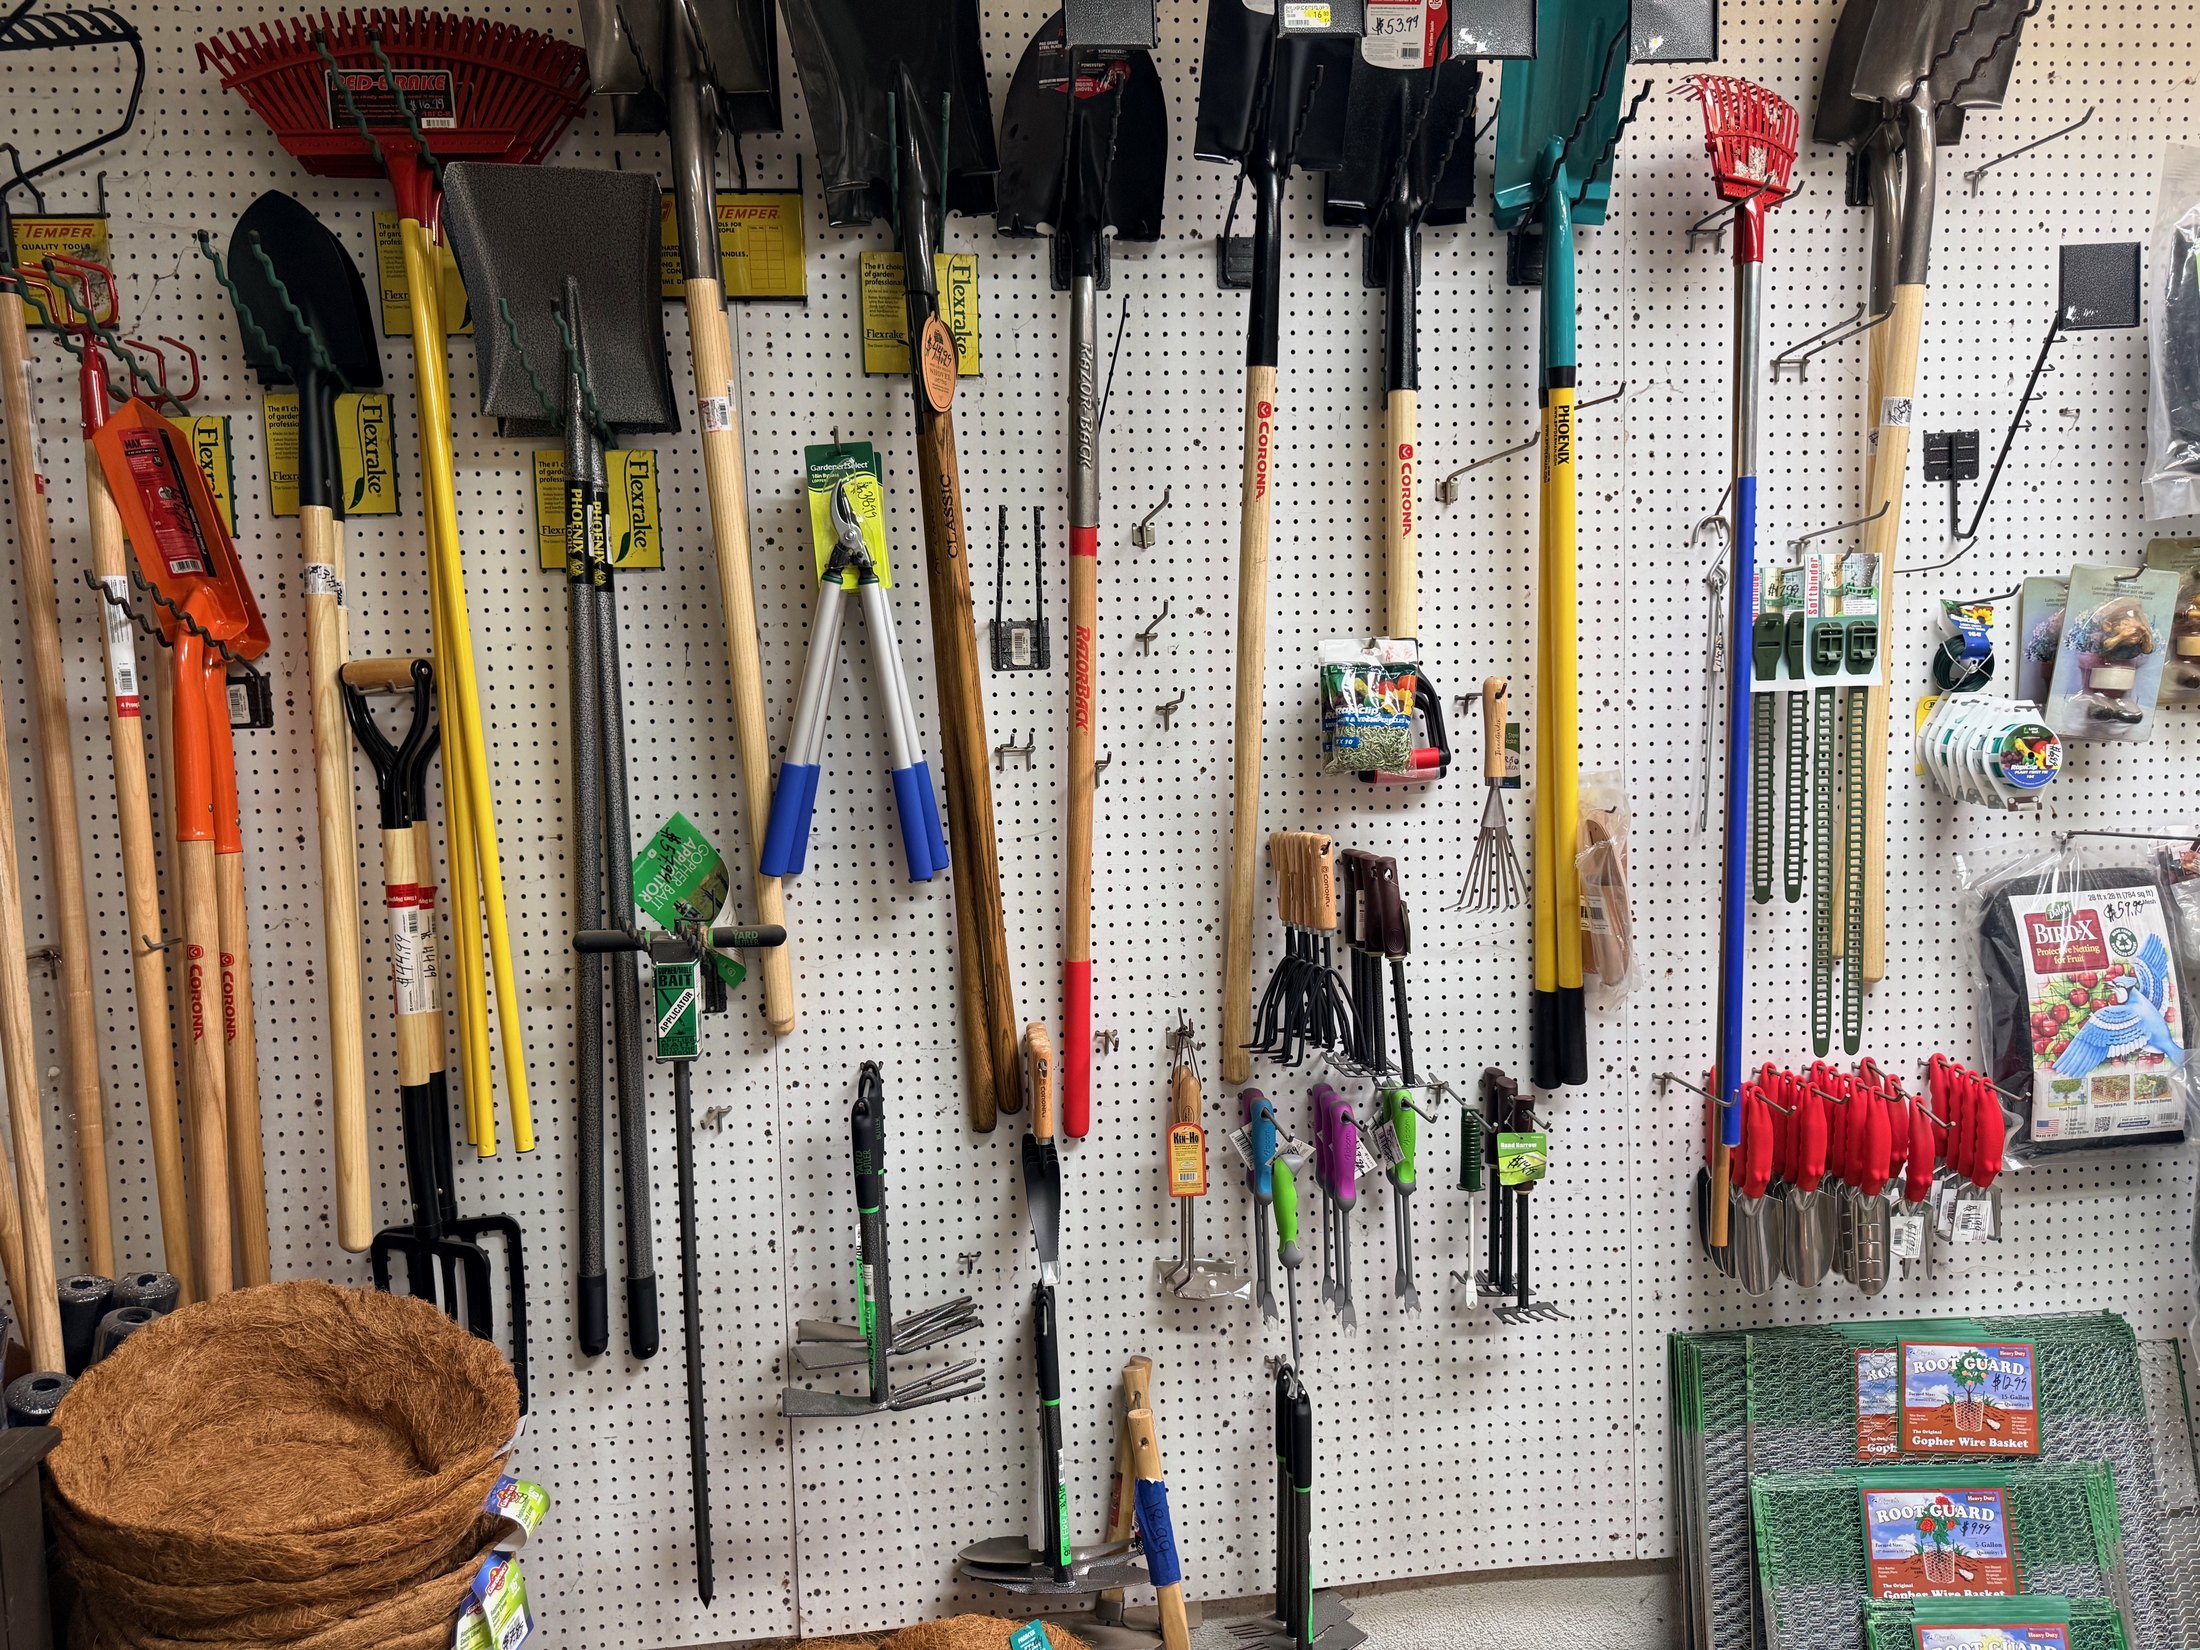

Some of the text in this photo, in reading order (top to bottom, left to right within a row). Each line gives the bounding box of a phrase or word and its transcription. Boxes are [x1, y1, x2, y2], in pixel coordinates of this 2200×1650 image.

[1372, 15, 1419, 35] $53.99
[717, 204, 780, 219] TEMPER
[23, 223, 95, 238] TEMPER
[22, 243, 59, 251] QUALITY
[872, 271, 895, 279] garden
[384, 290, 409, 299] Flexr
[952, 265, 973, 355] Flexrake
[866, 329, 905, 339] Flexrake
[1080, 342, 1094, 469] RAZOR-BACK
[1558, 405, 1569, 465] PHOENIX
[362, 404, 388, 494] Flexrake
[810, 463, 845, 471] Gardener
[1256, 421, 1270, 501] CORONA
[629, 460, 653, 548] Flexrake
[1401, 462, 1412, 537] CORONA
[571, 488, 584, 554] PHOENIX
[940, 474, 958, 559] CLASSIC
[542, 526, 565, 534] Flexr
[592, 501, 606, 564] PHOENIX
[1807, 557, 1819, 615] Softbinder
[1075, 624, 1091, 731] RAZORBACK
[670, 844, 709, 887] GOPHER
[651, 884, 675, 911] BAIT
[2107, 892, 2116, 900] 28
[2116, 892, 2122, 900] ft
[2122, 891, 2136, 899] (784
[2136, 892, 2145, 900] sq
[2145, 890, 2154, 898] ft)
[732, 930, 759, 938] YARD
[2032, 918, 2098, 945] BIRD-X
[2072, 943, 2101, 954] Netting
[394, 934, 415, 988] $44.99
[2054, 954, 2085, 964] for Fruit
[658, 974, 693, 987] BAIT
[190, 964, 204, 1042] CORONA
[222, 970, 236, 1042] CORONA
[659, 991, 694, 1033] APPLICATOR
[855, 1150, 863, 1176] YARD
[862, 1149, 872, 1175] BUTLER
[1913, 1356, 2026, 1375] ROOT GUARD
[1990, 1373, 2028, 1392] $12.99
[2001, 1393, 2030, 1401] 15-Gallon
[1867, 1442, 1897, 1454] Goph
[1911, 1435, 2029, 1449] Gopher Wire Basket
[1967, 1495, 1982, 1503] Heavy
[1876, 1504, 1996, 1524] ROOT GUARD
[1959, 1520, 1991, 1537] $9.99
[1884, 1588, 2006, 1599] Gopher Wire Basket
